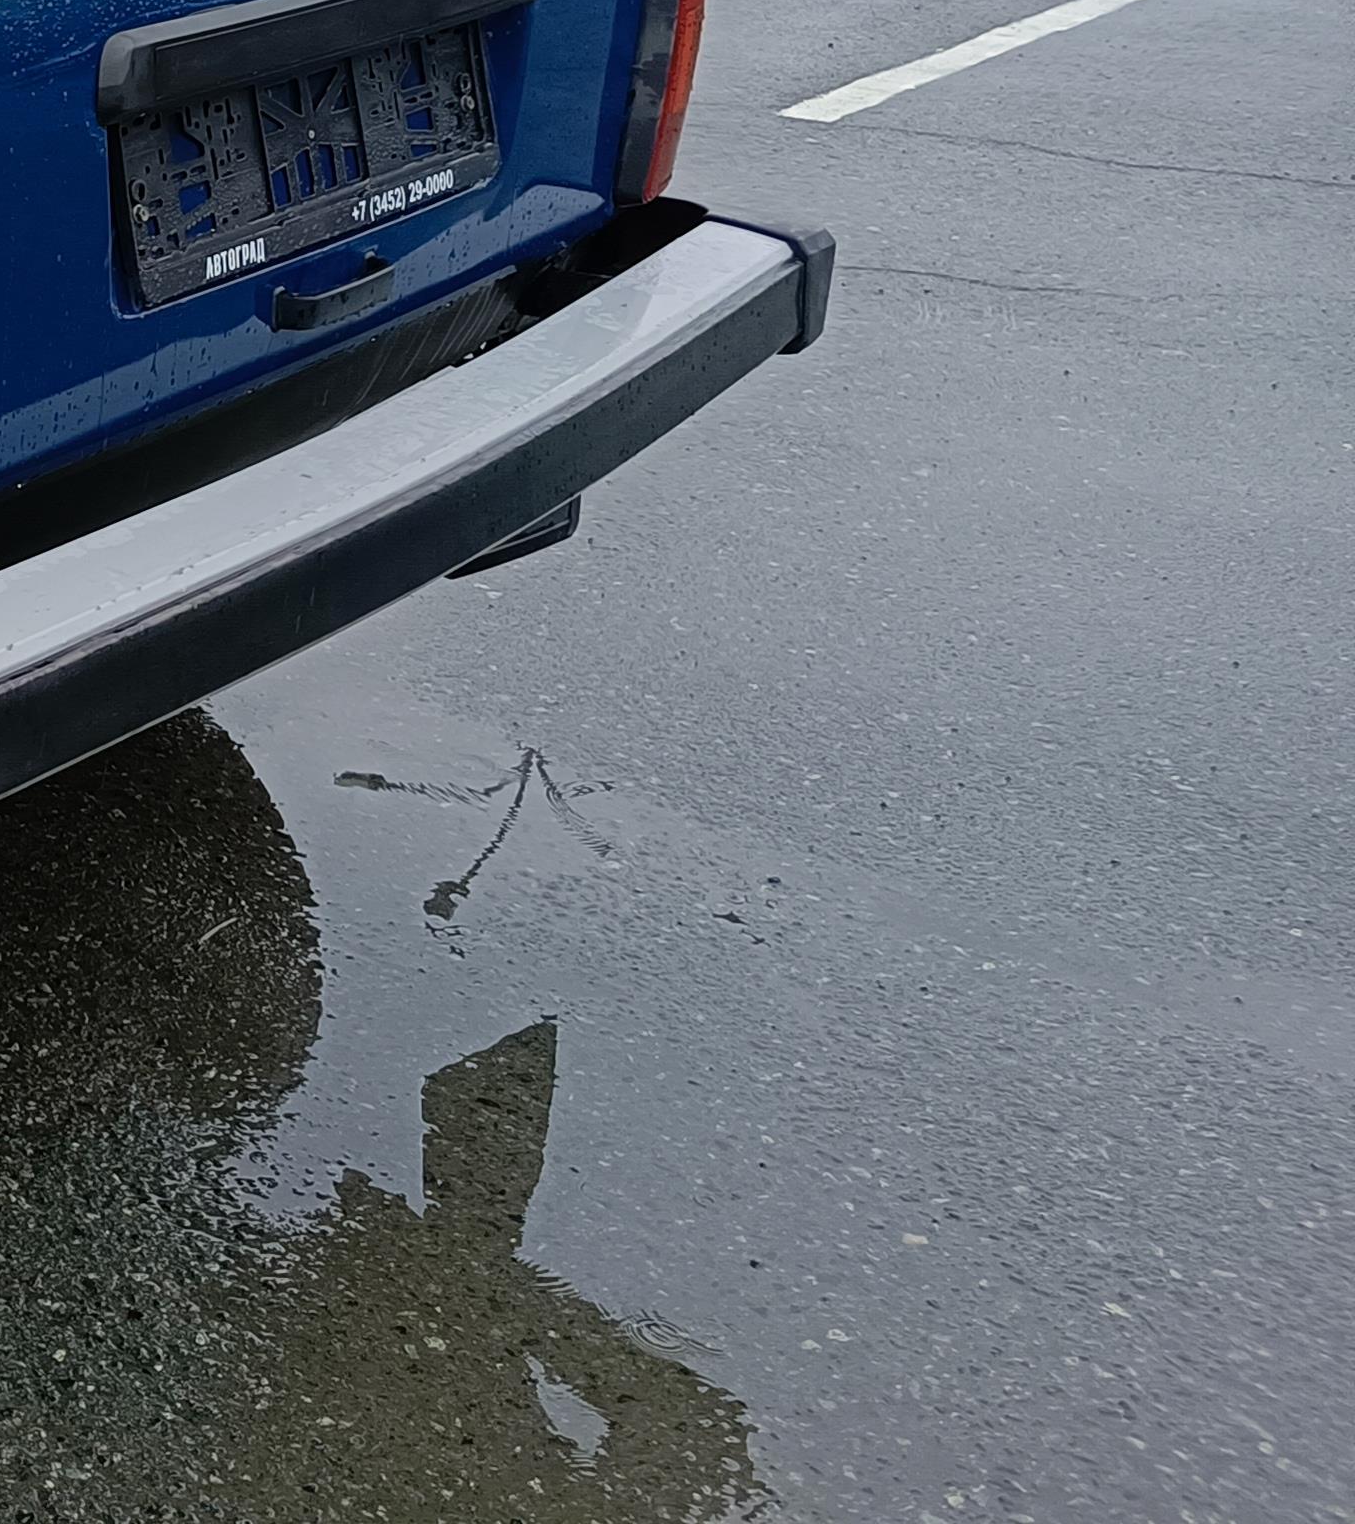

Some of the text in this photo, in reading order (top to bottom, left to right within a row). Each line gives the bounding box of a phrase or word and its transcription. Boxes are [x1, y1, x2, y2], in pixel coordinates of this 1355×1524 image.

[351, 169, 454, 222] +7 (3452) 29-0000
[207, 238, 266, 279] АВТОГРАД
